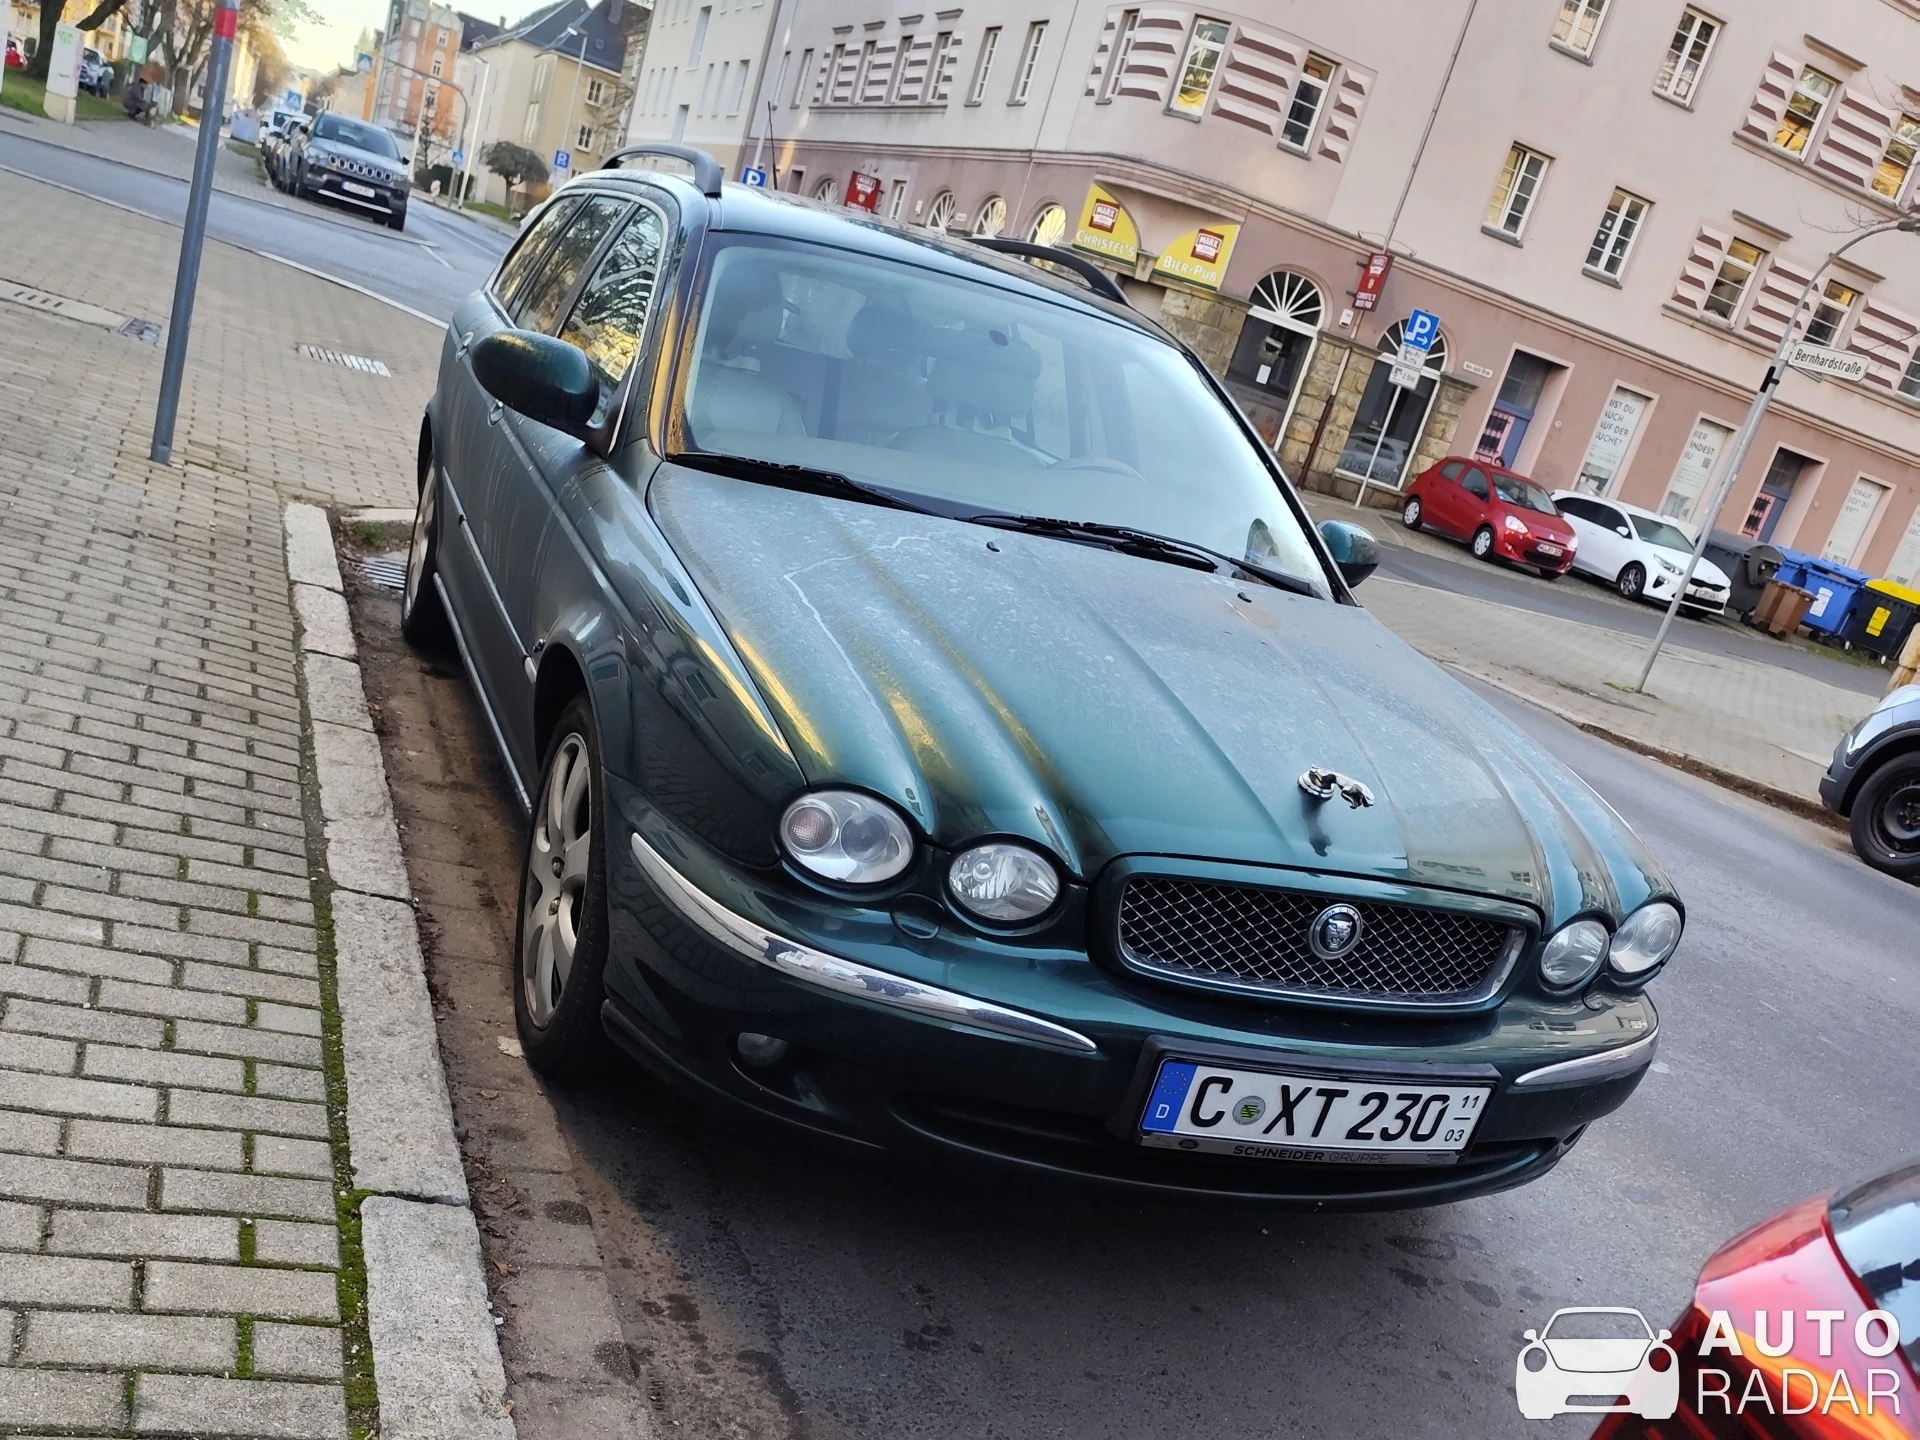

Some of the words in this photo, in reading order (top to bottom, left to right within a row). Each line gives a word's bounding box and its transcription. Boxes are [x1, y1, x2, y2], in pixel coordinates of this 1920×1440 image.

[747, 170, 761, 186] P
[1096, 205, 1117, 218] MARX
[1198, 235, 1220, 249] MARX
[1409, 314, 1432, 342] P
[1794, 348, 1862, 375] Bernhardstraße
[1623, 403, 1636, 414] DU
[1613, 423, 1630, 437] DER
[1689, 441, 1715, 456] INDEST
[1155, 1103, 1170, 1119] D
[1189, 1076, 1234, 1128] C
[1262, 1084, 1350, 1137] XT
[1345, 1090, 1453, 1143] 230
[1460, 1095, 1481, 1109] 11
[1443, 1128, 1464, 1143] 03
[1233, 1145, 1325, 1161] SCHNEIDER
[1328, 1152, 1390, 1164] GRUPPE
